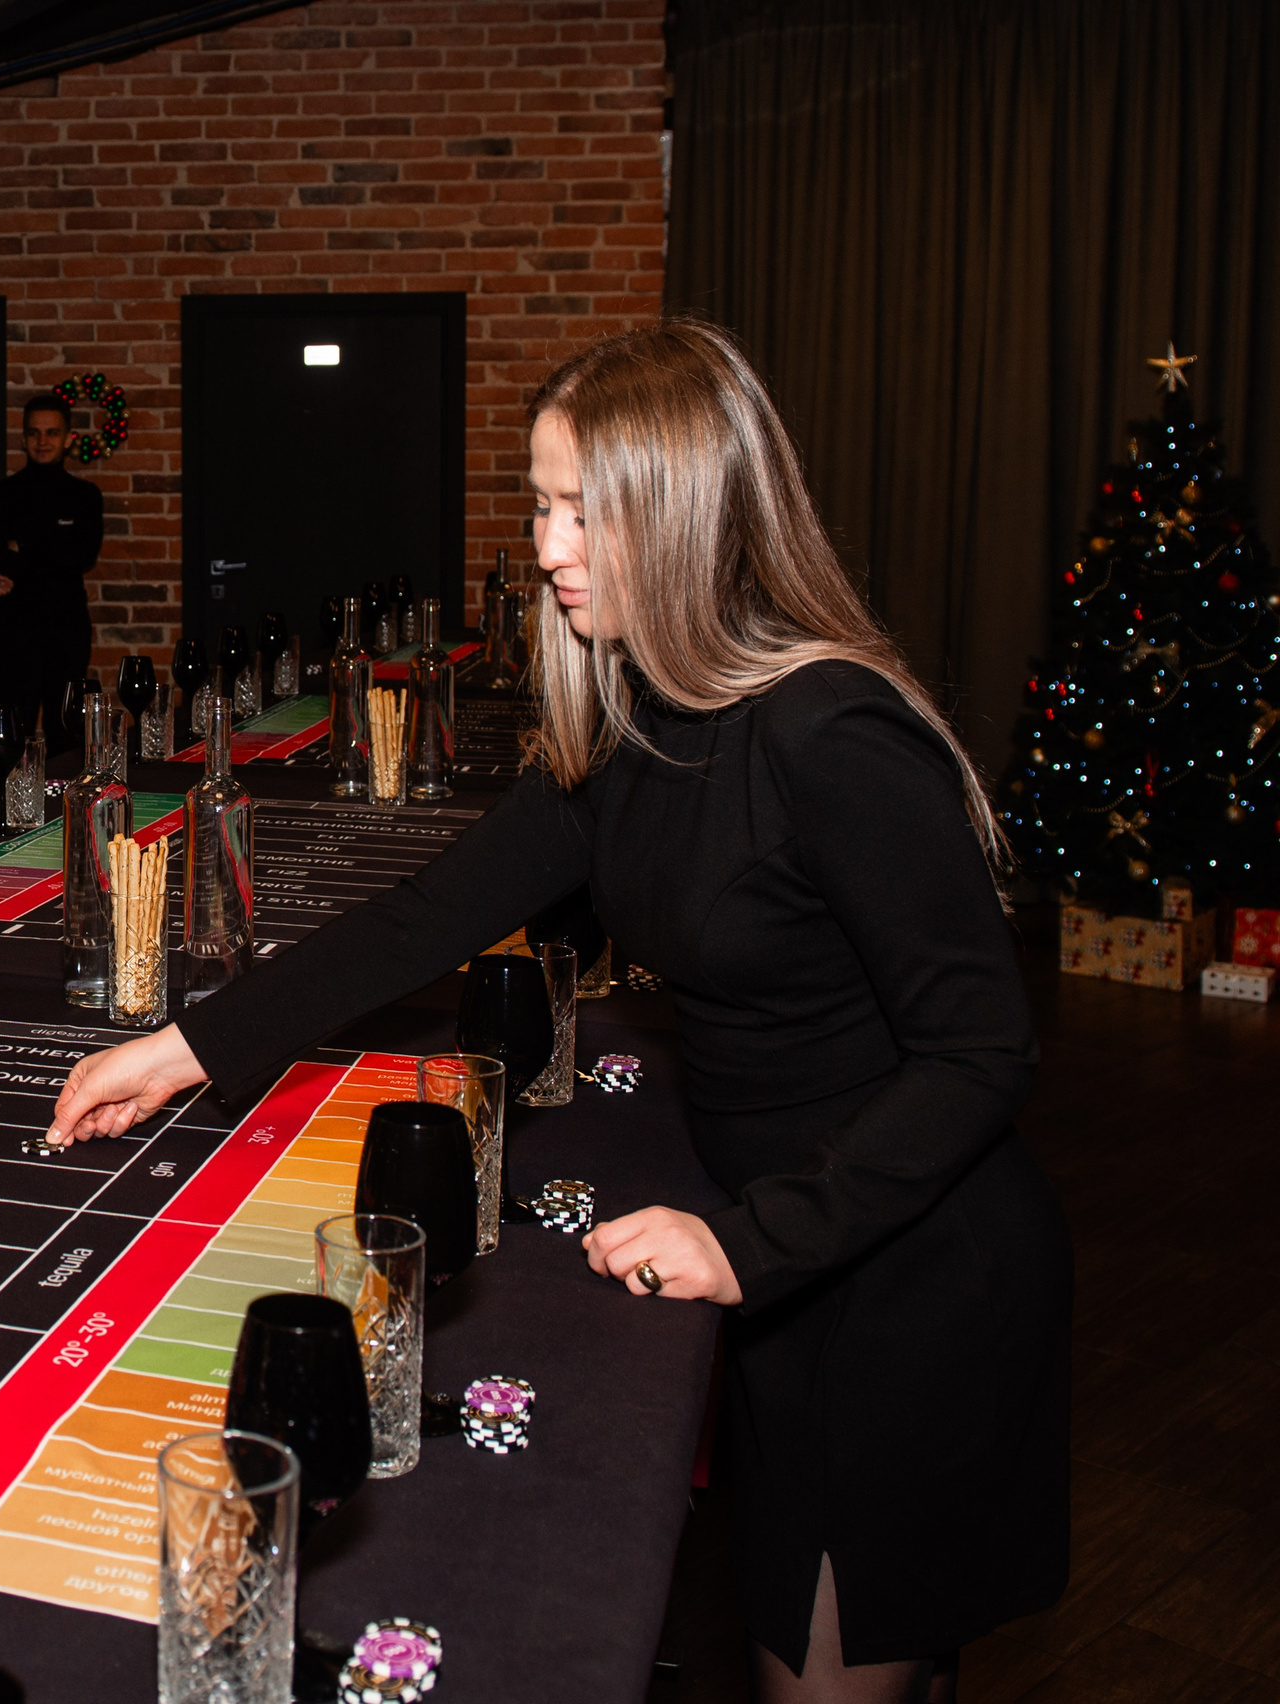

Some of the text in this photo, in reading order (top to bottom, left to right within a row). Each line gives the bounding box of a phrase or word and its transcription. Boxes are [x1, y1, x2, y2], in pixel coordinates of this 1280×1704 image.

[317, 833, 357, 841] FLIP
[254, 855, 356, 867] SMOOTHIE
[266, 869, 310, 877] FIZZ
[266, 897, 334, 907] STYLE
[30, 1027, 98, 1039] digestif
[149, 1160, 177, 1178] gin
[38, 1246, 94, 1289] tequila
[44, 1466, 156, 1495] мускатный
[36, 1513, 121, 1538] лесной
[94, 1565, 158, 1586] other
[64, 1575, 150, 1602] другое
